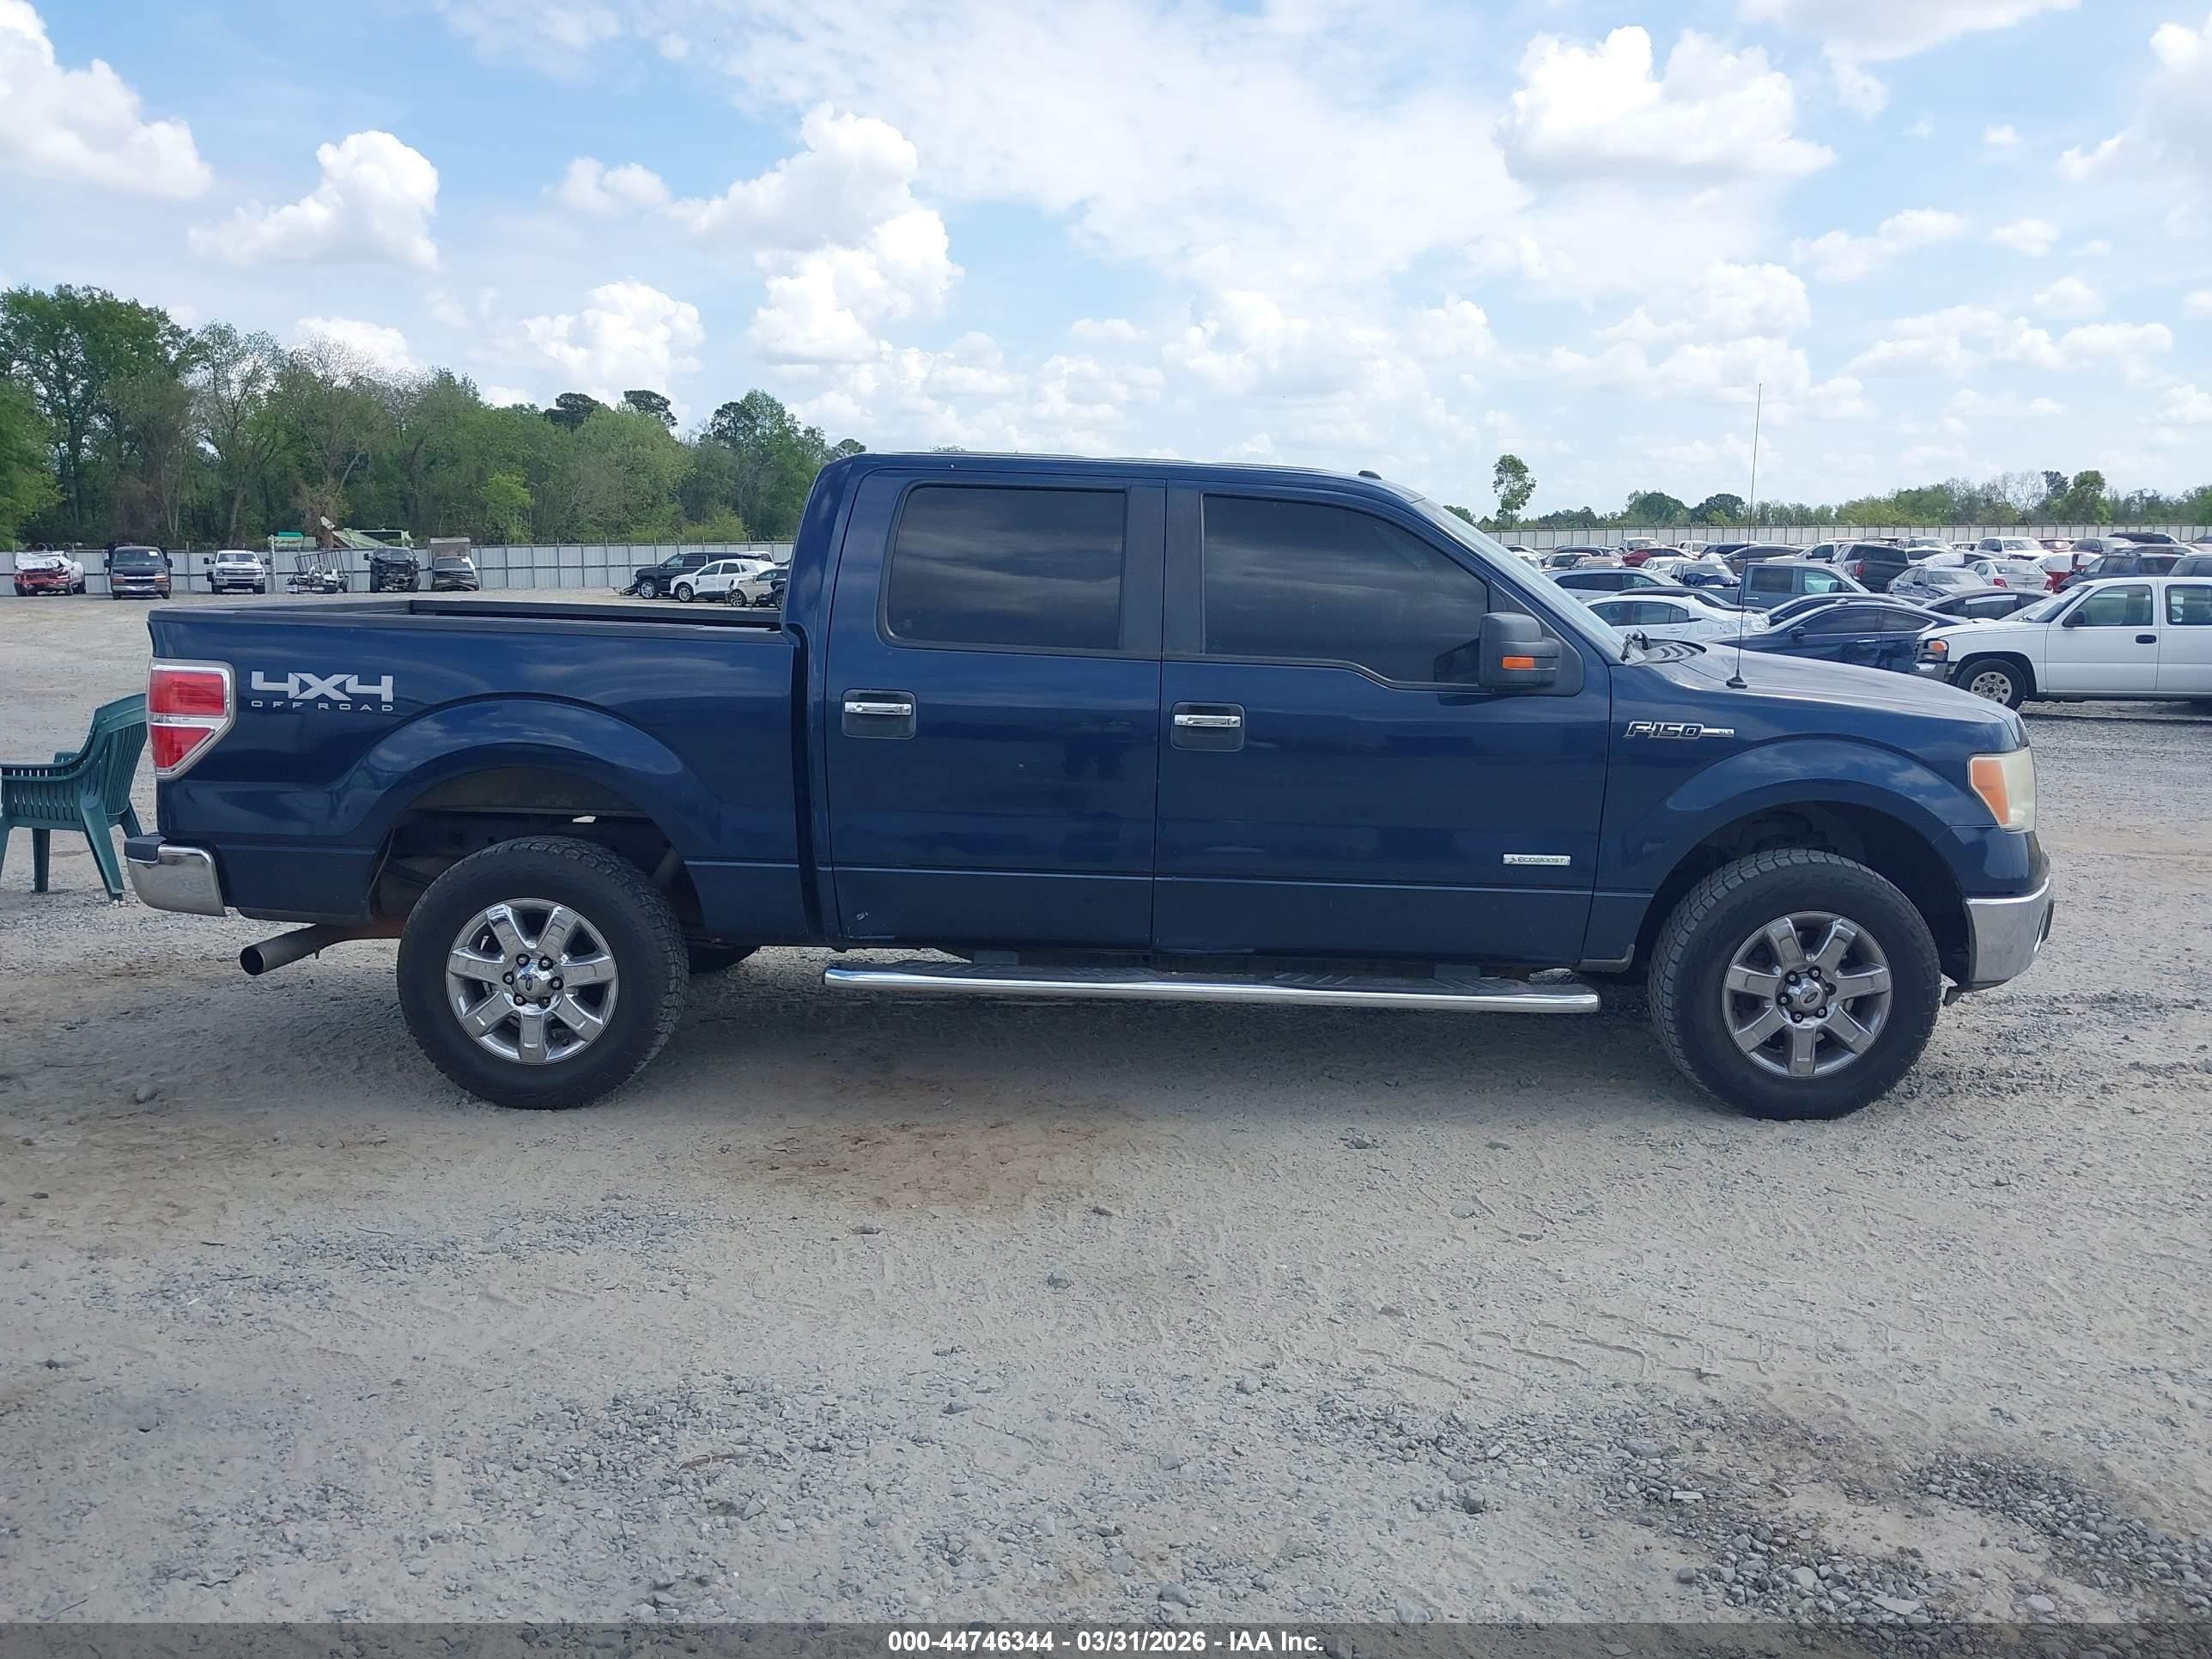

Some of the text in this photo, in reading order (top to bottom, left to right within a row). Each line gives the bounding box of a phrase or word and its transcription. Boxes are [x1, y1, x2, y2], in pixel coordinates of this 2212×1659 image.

[251, 671, 393, 702] 4X4
[251, 700, 393, 712] OFF ROAD
